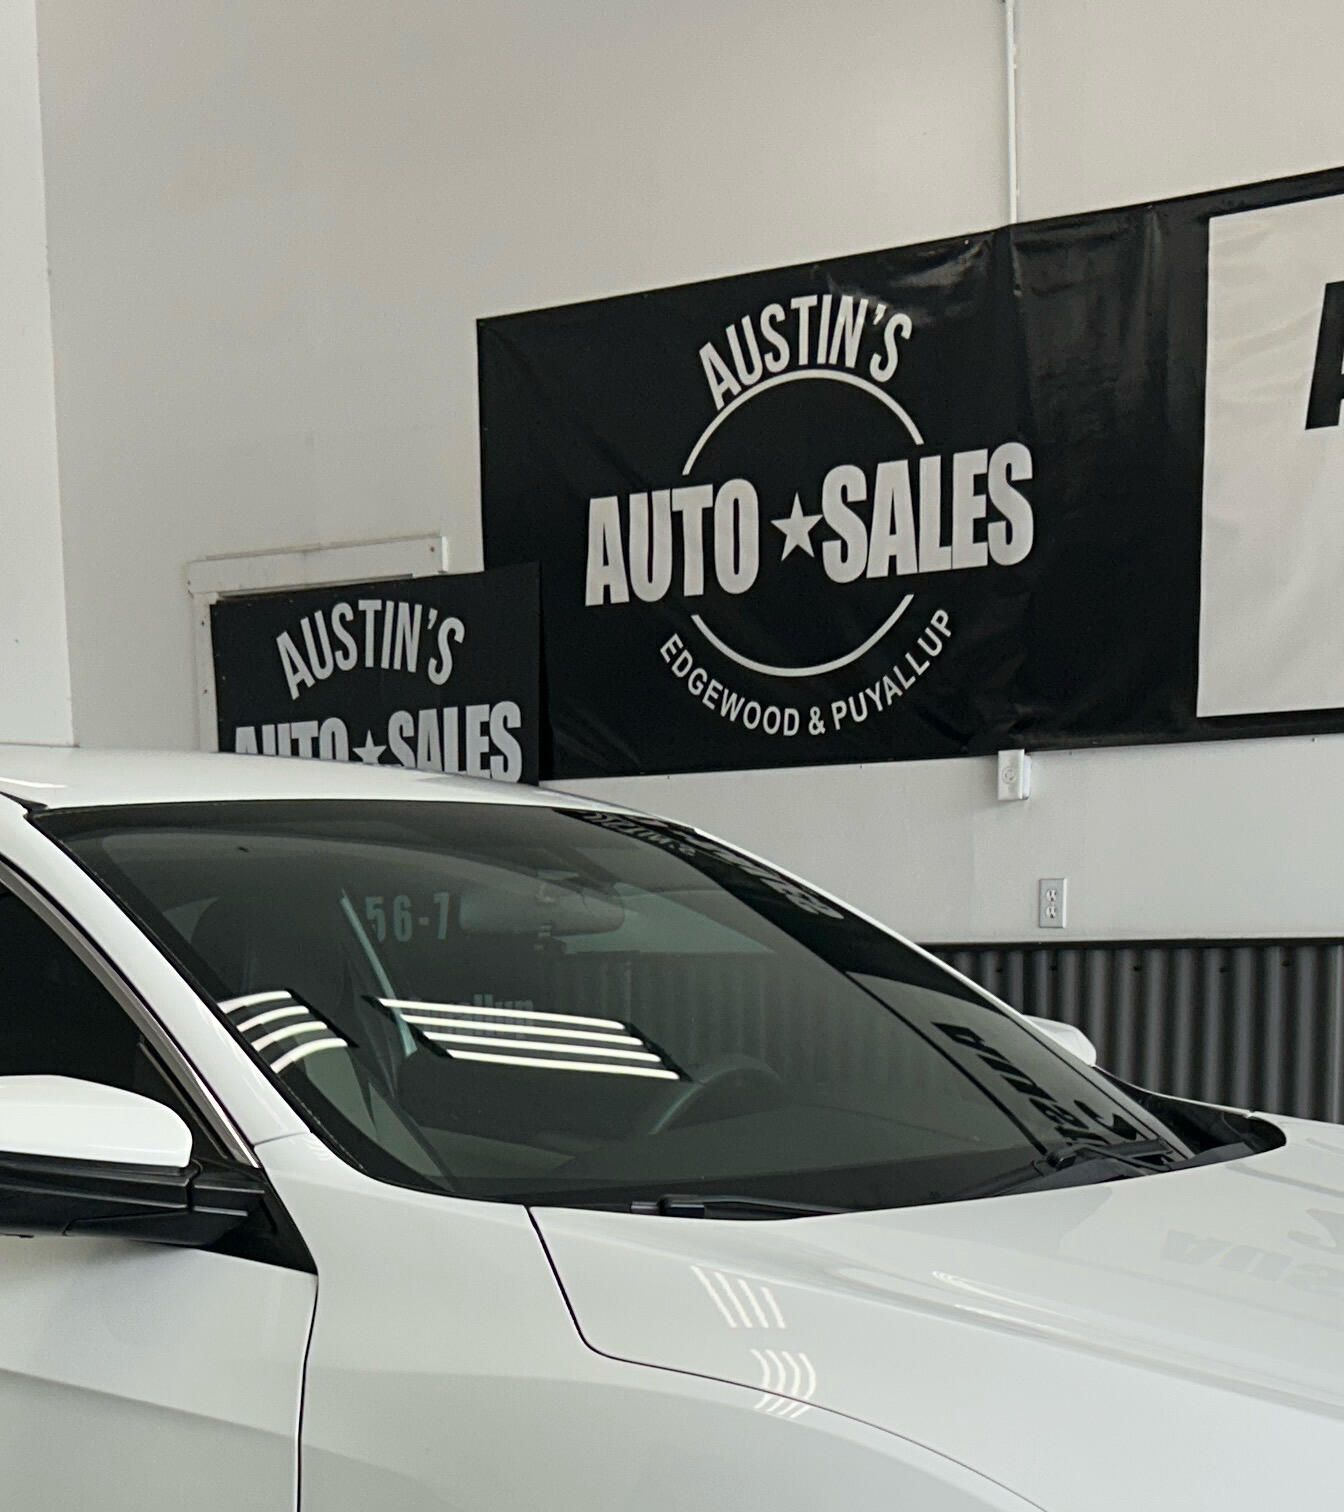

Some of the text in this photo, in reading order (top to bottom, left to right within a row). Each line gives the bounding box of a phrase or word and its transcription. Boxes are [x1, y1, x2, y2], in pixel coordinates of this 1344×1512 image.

[698, 294, 913, 411] AUSTIN'S
[584, 441, 1035, 607] AUTO SALES
[276, 599, 465, 700] AUSTIN'S
[660, 608, 953, 738] EDGEWOOD & PUYALLUP
[387, 700, 523, 783] SALES
